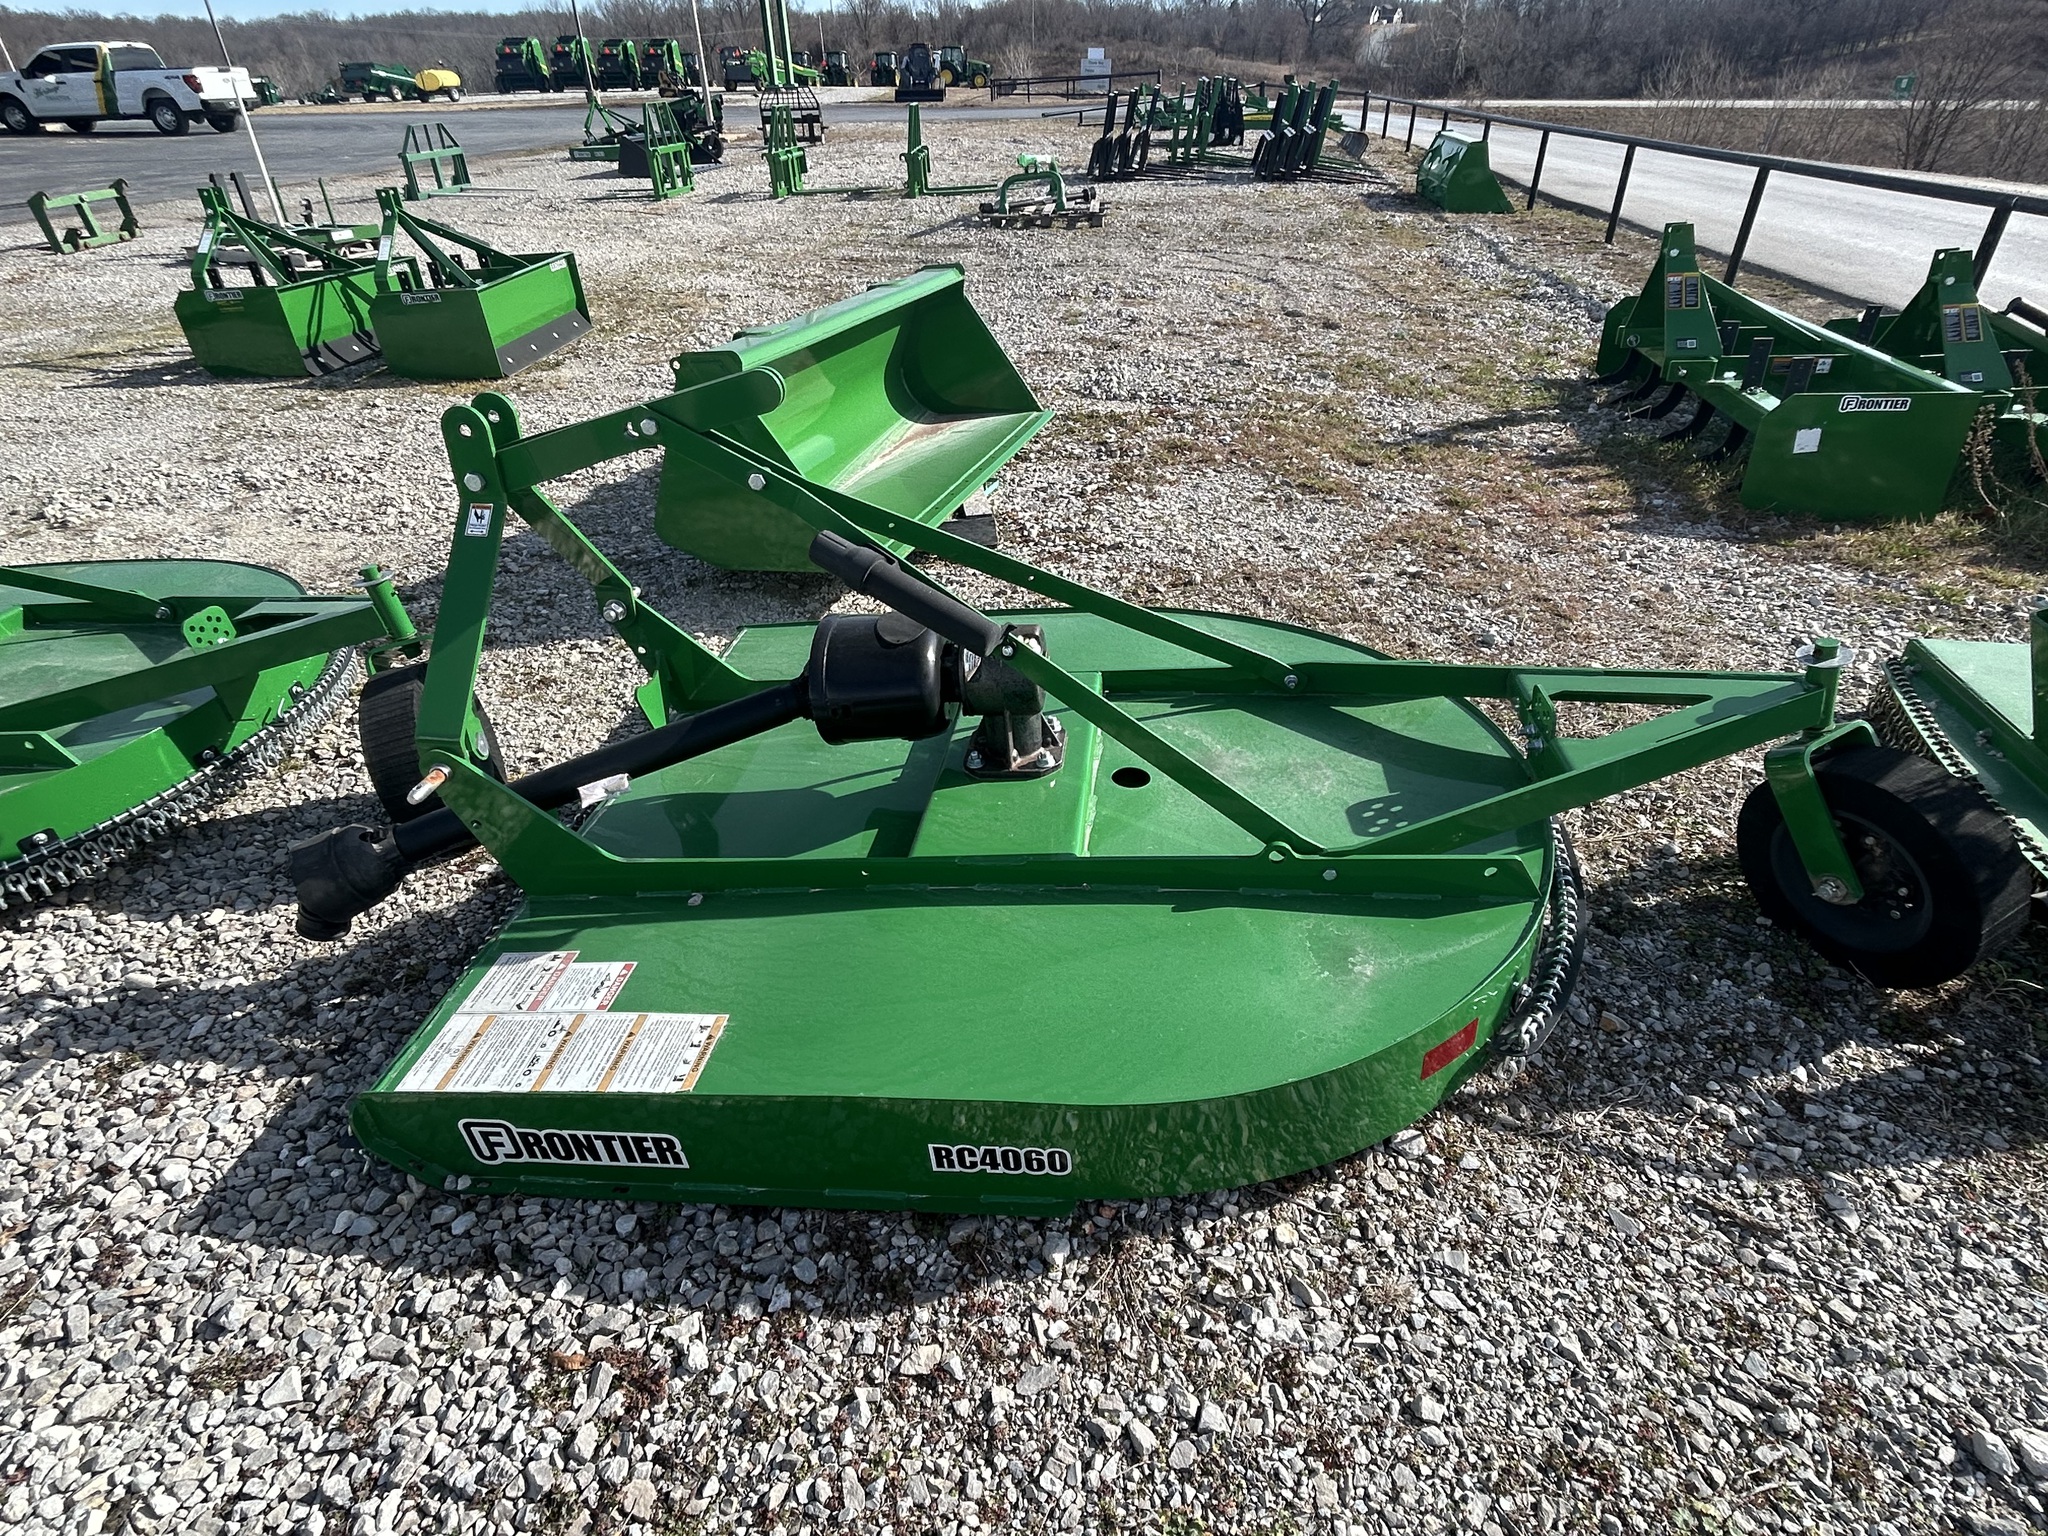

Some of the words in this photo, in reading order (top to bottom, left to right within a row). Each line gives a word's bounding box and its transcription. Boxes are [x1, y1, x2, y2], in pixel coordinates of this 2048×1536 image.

[205, 290, 243, 301] FRONTIER
[402, 294, 441, 304] FRONTIER
[1839, 396, 1910, 412] FRONTIER
[535, 970, 562, 1001] DANGER
[600, 976, 625, 1005] DANGER
[451, 1039, 478, 1070] WARNING
[544, 1038, 570, 1069] WARNING
[609, 1039, 633, 1071] WARNING
[691, 1041, 713, 1072] WARNING
[462, 1120, 684, 1165] FRONTIER
[932, 1146, 1069, 1173] RC4060
